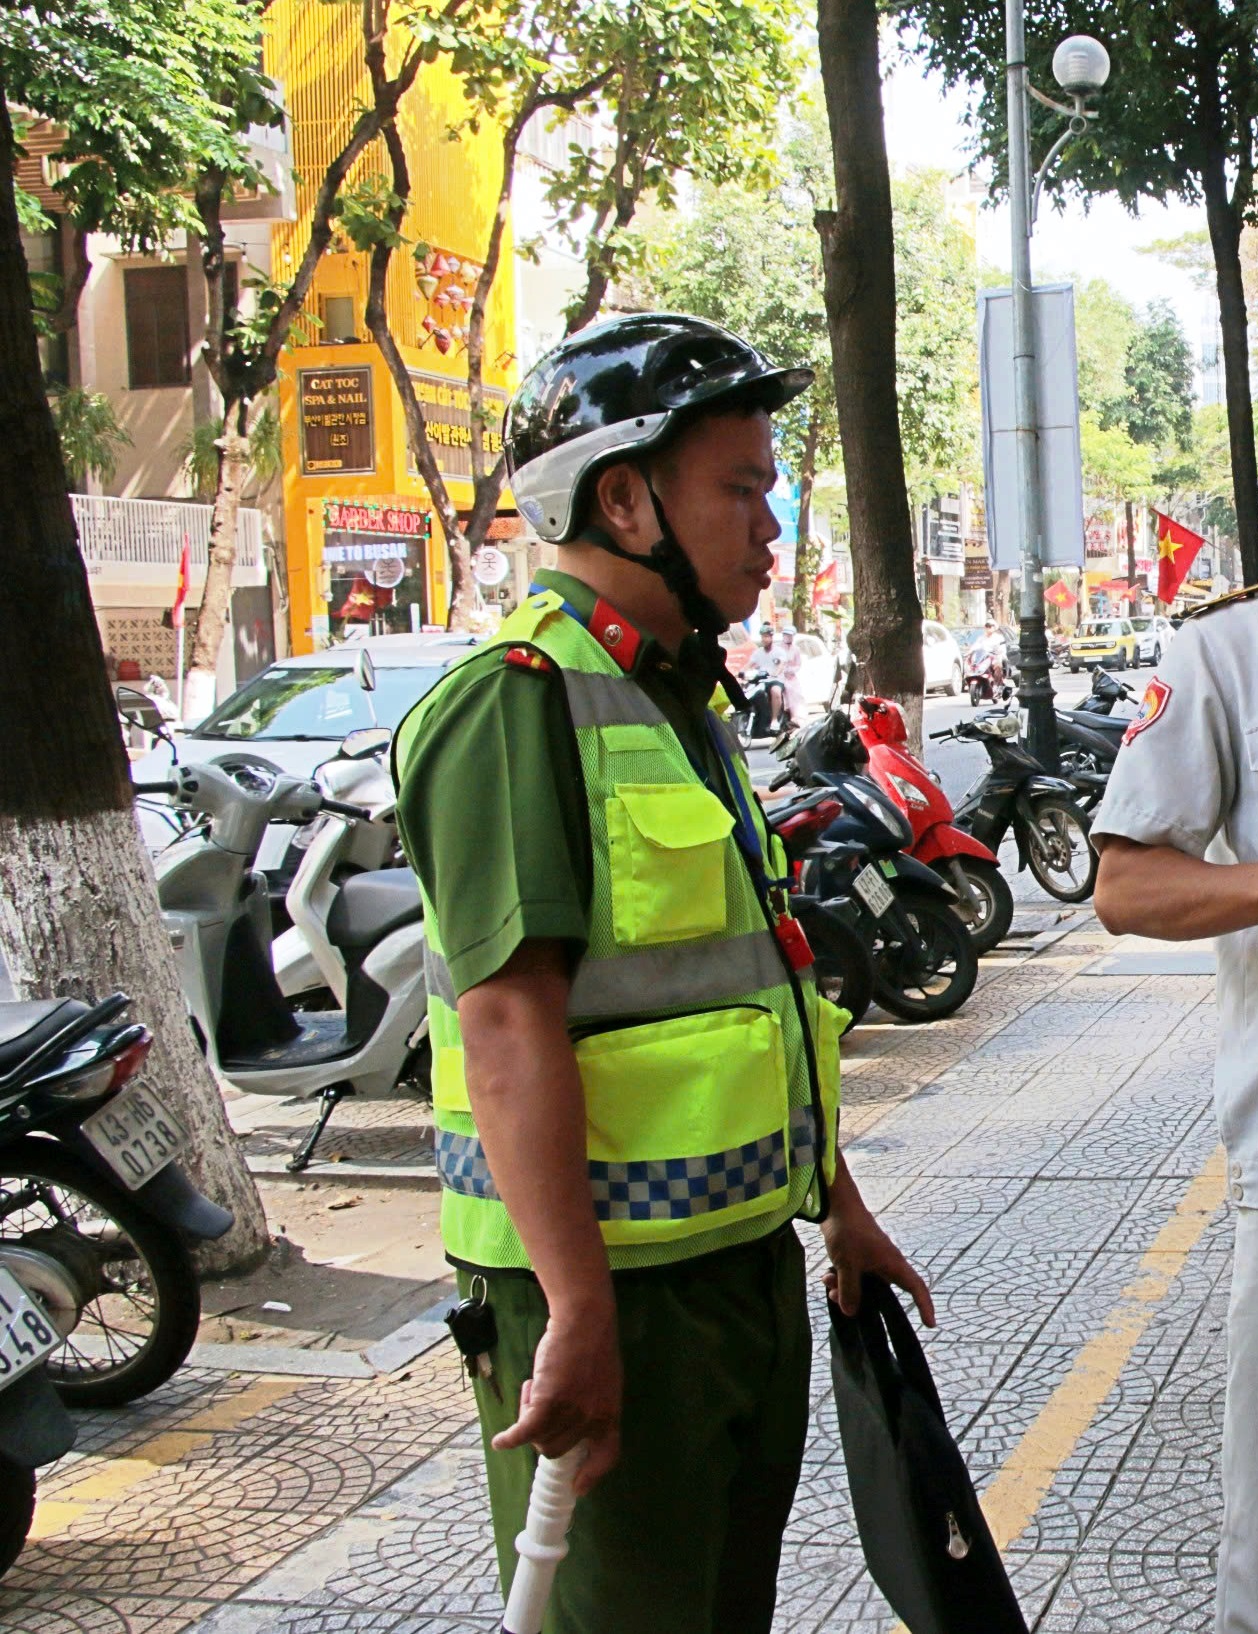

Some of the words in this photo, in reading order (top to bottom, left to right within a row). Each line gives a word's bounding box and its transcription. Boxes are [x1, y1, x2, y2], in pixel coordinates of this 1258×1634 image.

[304, 395, 326, 405] SPA
[327, 395, 337, 404] &
[338, 393, 367, 403] NAIL
[330, 506, 385, 530] BARBER
[387, 510, 421, 534] SHOP
[121, 1120, 179, 1177] 0738
